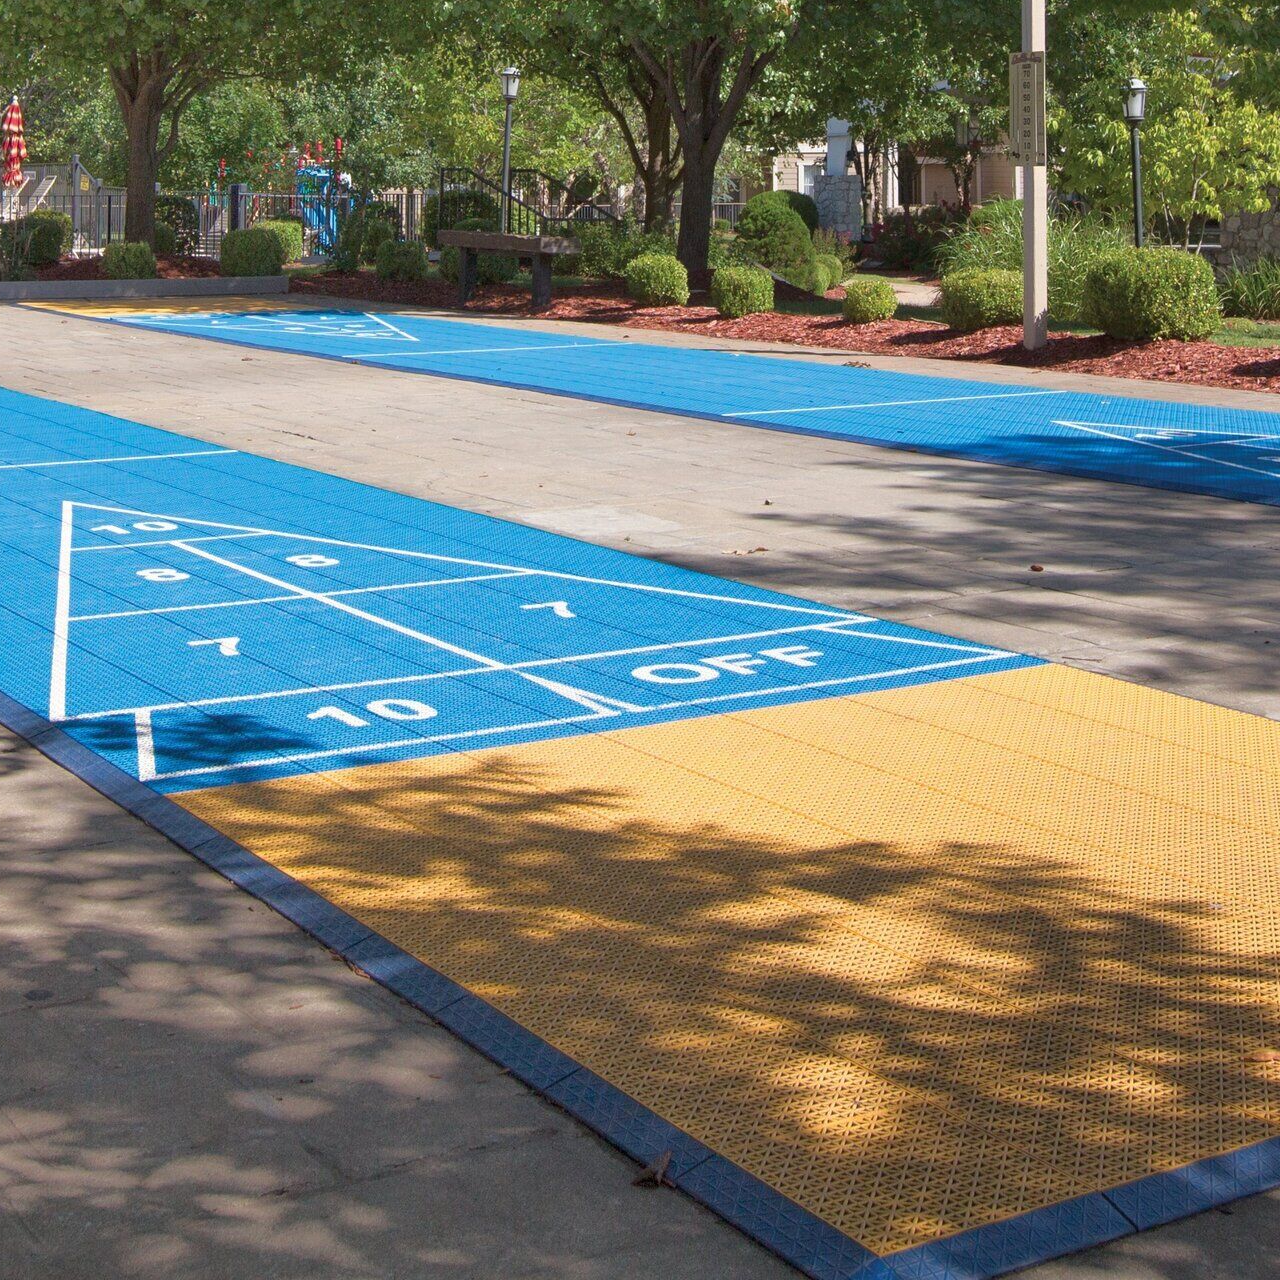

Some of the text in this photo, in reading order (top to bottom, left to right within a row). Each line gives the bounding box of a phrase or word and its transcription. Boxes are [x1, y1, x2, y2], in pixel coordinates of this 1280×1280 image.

[1023, 70, 1031, 78] 70
[1023, 81, 1031, 89] 60
[1023, 93, 1031, 101] 50
[1023, 105, 1031, 113] 40
[1023, 117, 1031, 125] 30
[1023, 130, 1031, 138] 20
[1024, 142, 1031, 150] 10
[90, 521, 179, 536] 10
[284, 554, 340, 568] 8
[135, 568, 191, 582] 8
[519, 600, 577, 619] 7
[186, 636, 242, 657] 7
[630, 645, 825, 685] OFF
[306, 698, 439, 728] 10
